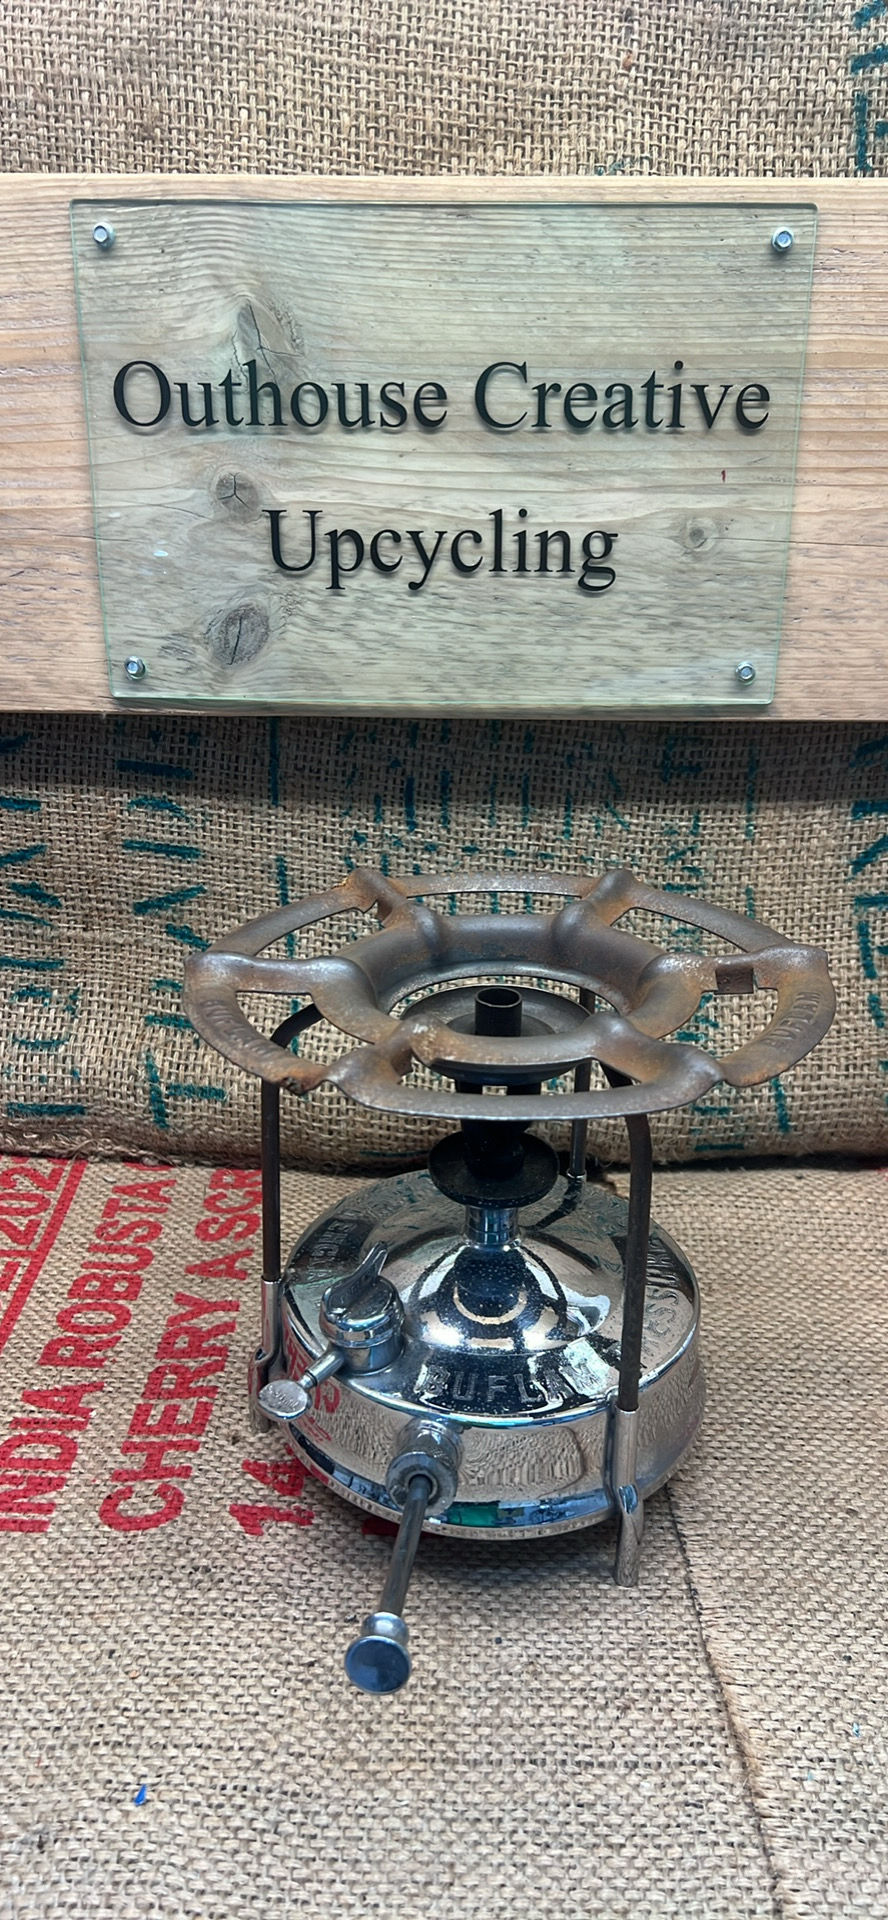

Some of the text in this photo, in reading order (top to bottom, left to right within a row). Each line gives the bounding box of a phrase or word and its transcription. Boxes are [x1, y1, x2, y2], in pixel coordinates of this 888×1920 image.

[113, 360, 771, 431] Outhouse Creative
[265, 509, 619, 592] Upcycling
[0, 1157, 67, 1246] 202
[38, 1178, 177, 1369] ROBUSTA
[99, 1292, 241, 1533] CHERRY
[185, 1248, 253, 1281] A
[0, 1381, 105, 1534] INDIA
